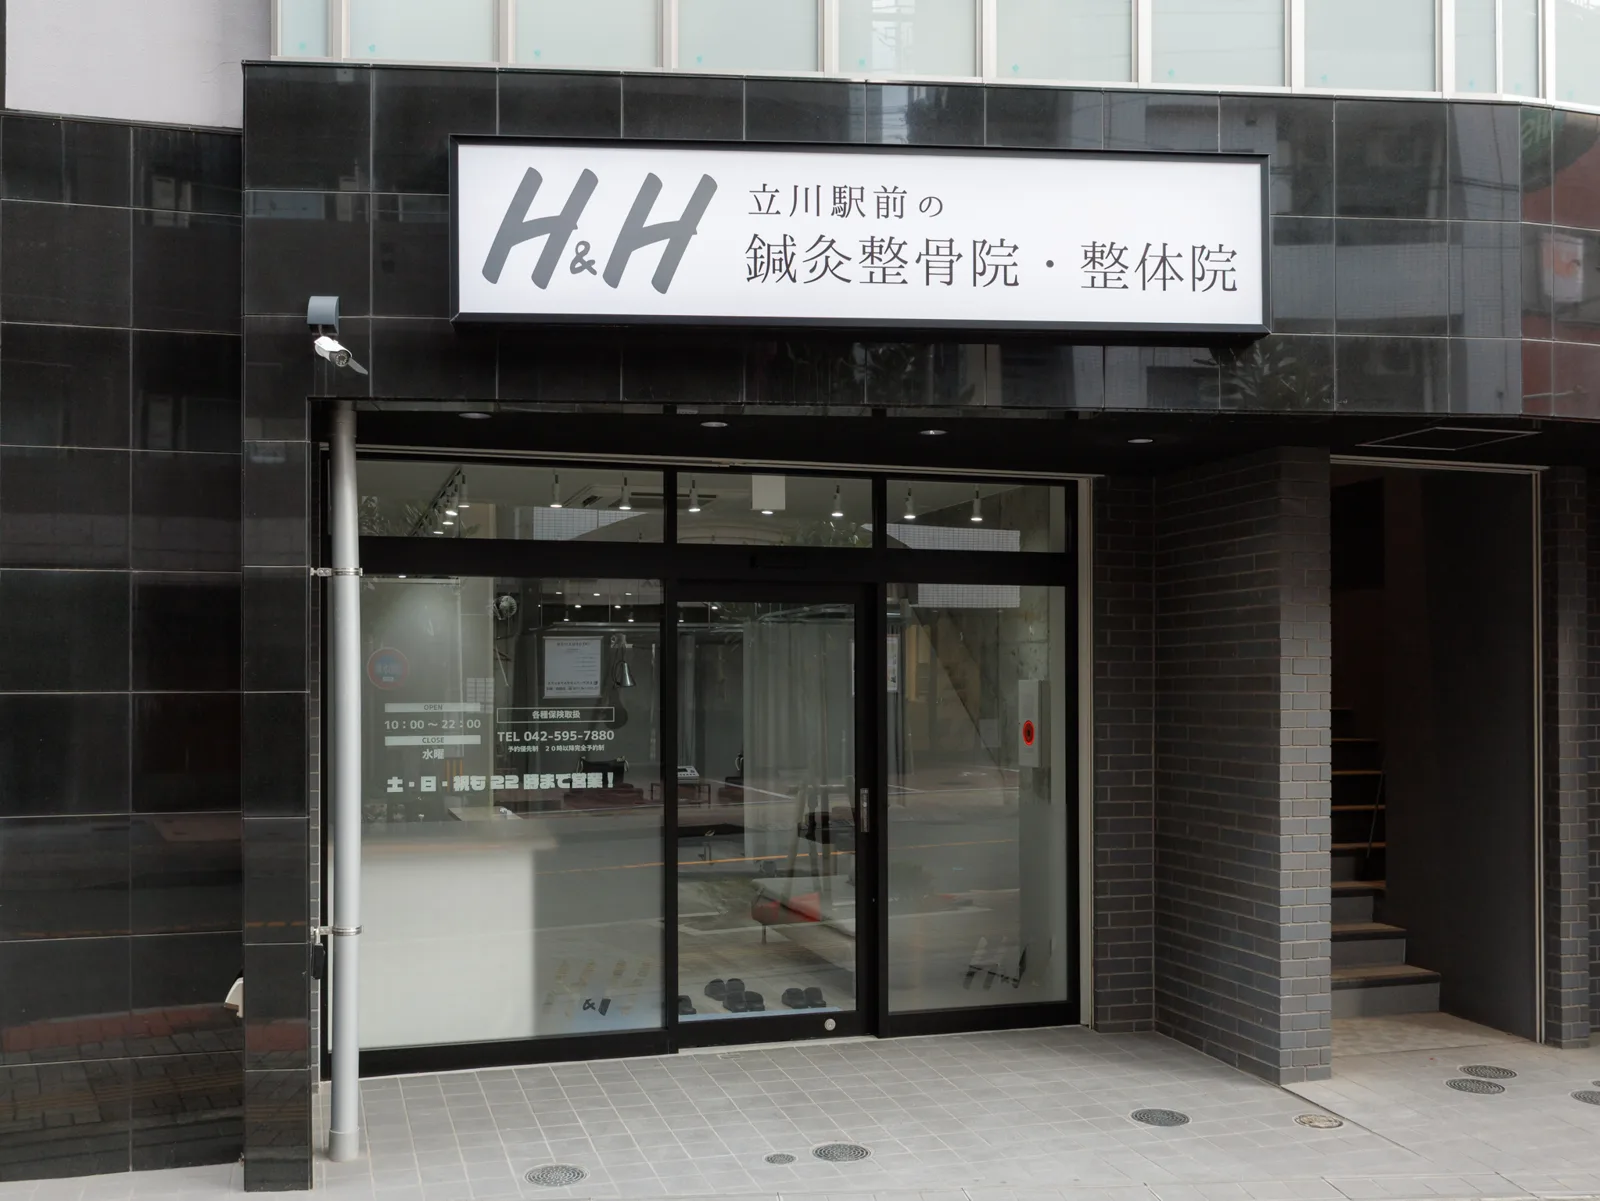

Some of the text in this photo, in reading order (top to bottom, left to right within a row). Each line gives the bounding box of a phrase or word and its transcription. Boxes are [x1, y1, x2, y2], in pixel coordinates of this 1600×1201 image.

[748, 183, 943, 220] 立川駅前の
[482, 166, 718, 294] H&H
[745, 233, 1238, 293] 鍼灸整骨院・整体院
[532, 710, 581, 719] 各種保険取扱
[497, 730, 615, 742] TEL 042-595-7880
[422, 748, 445, 760] 水曜
